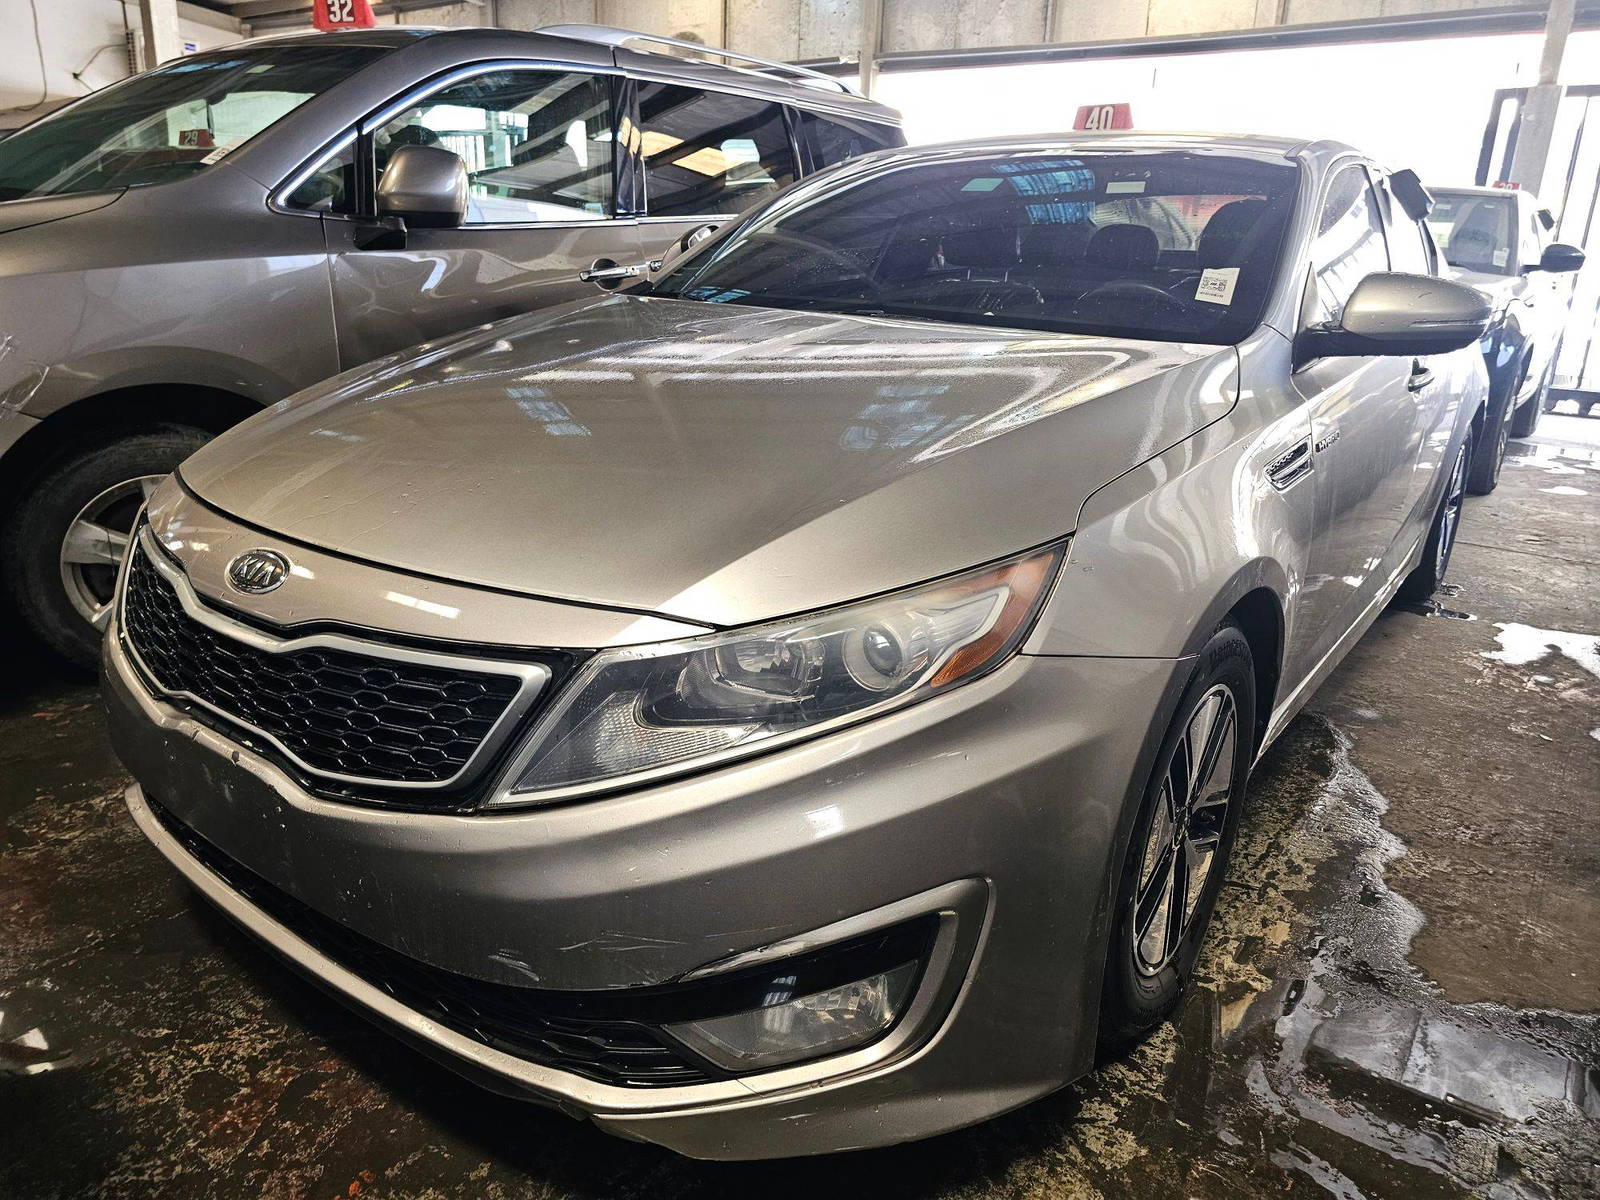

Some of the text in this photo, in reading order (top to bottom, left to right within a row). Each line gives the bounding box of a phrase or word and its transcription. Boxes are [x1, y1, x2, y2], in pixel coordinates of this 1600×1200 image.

[326, 0, 355, 22] 32
[1085, 106, 1114, 130] 40
[184, 131, 199, 146] 29
[232, 555, 277, 587] KIA
